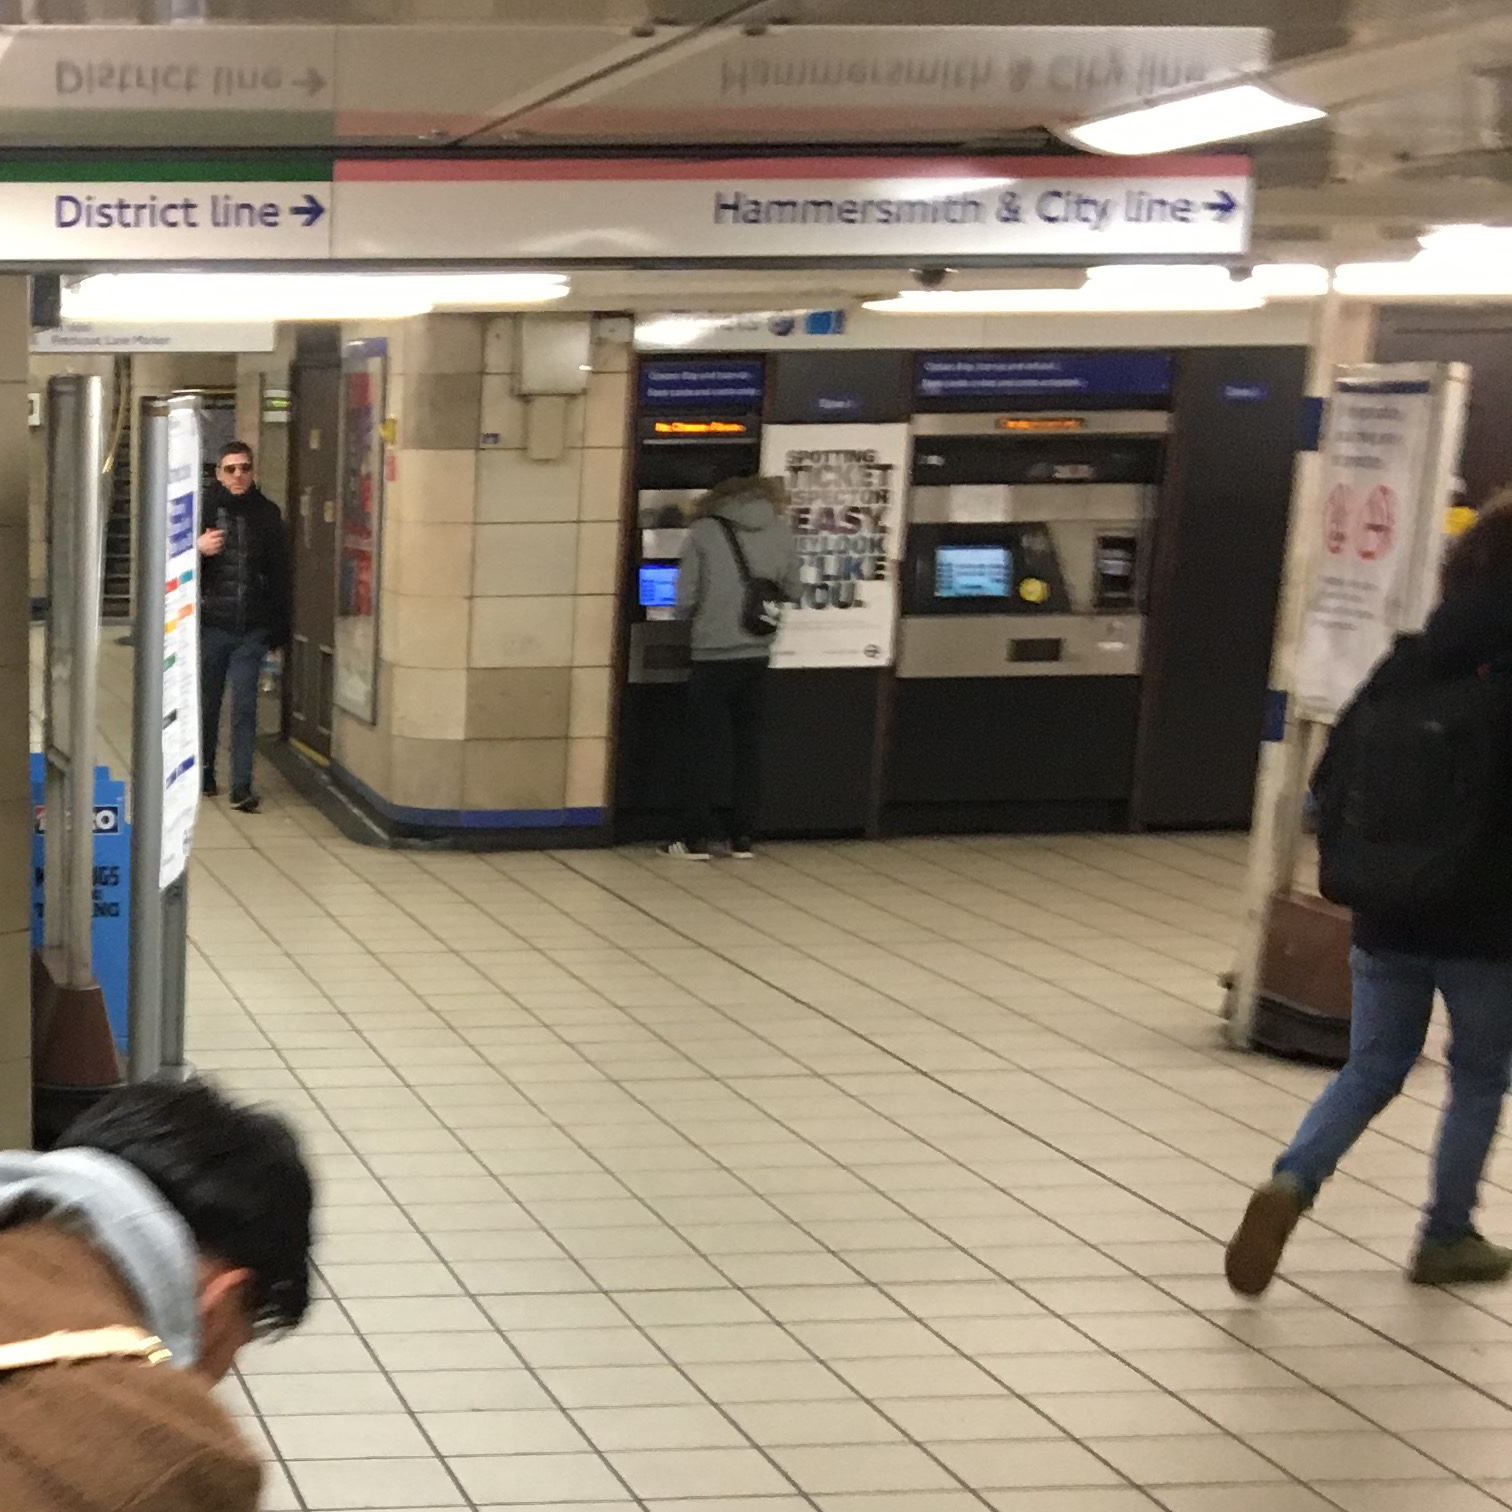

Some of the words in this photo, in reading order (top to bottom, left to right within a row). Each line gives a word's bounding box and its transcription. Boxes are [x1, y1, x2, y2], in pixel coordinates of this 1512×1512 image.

[55, 194, 199, 228] District
[210, 194, 280, 228] line
[713, 189, 984, 225] Hammersmith
[994, 190, 1024, 224] &
[1035, 189, 1112, 231] City
[1123, 189, 1192, 225] line
[786, 449, 877, 464] SPOTTING
[785, 464, 894, 488] TICKET
